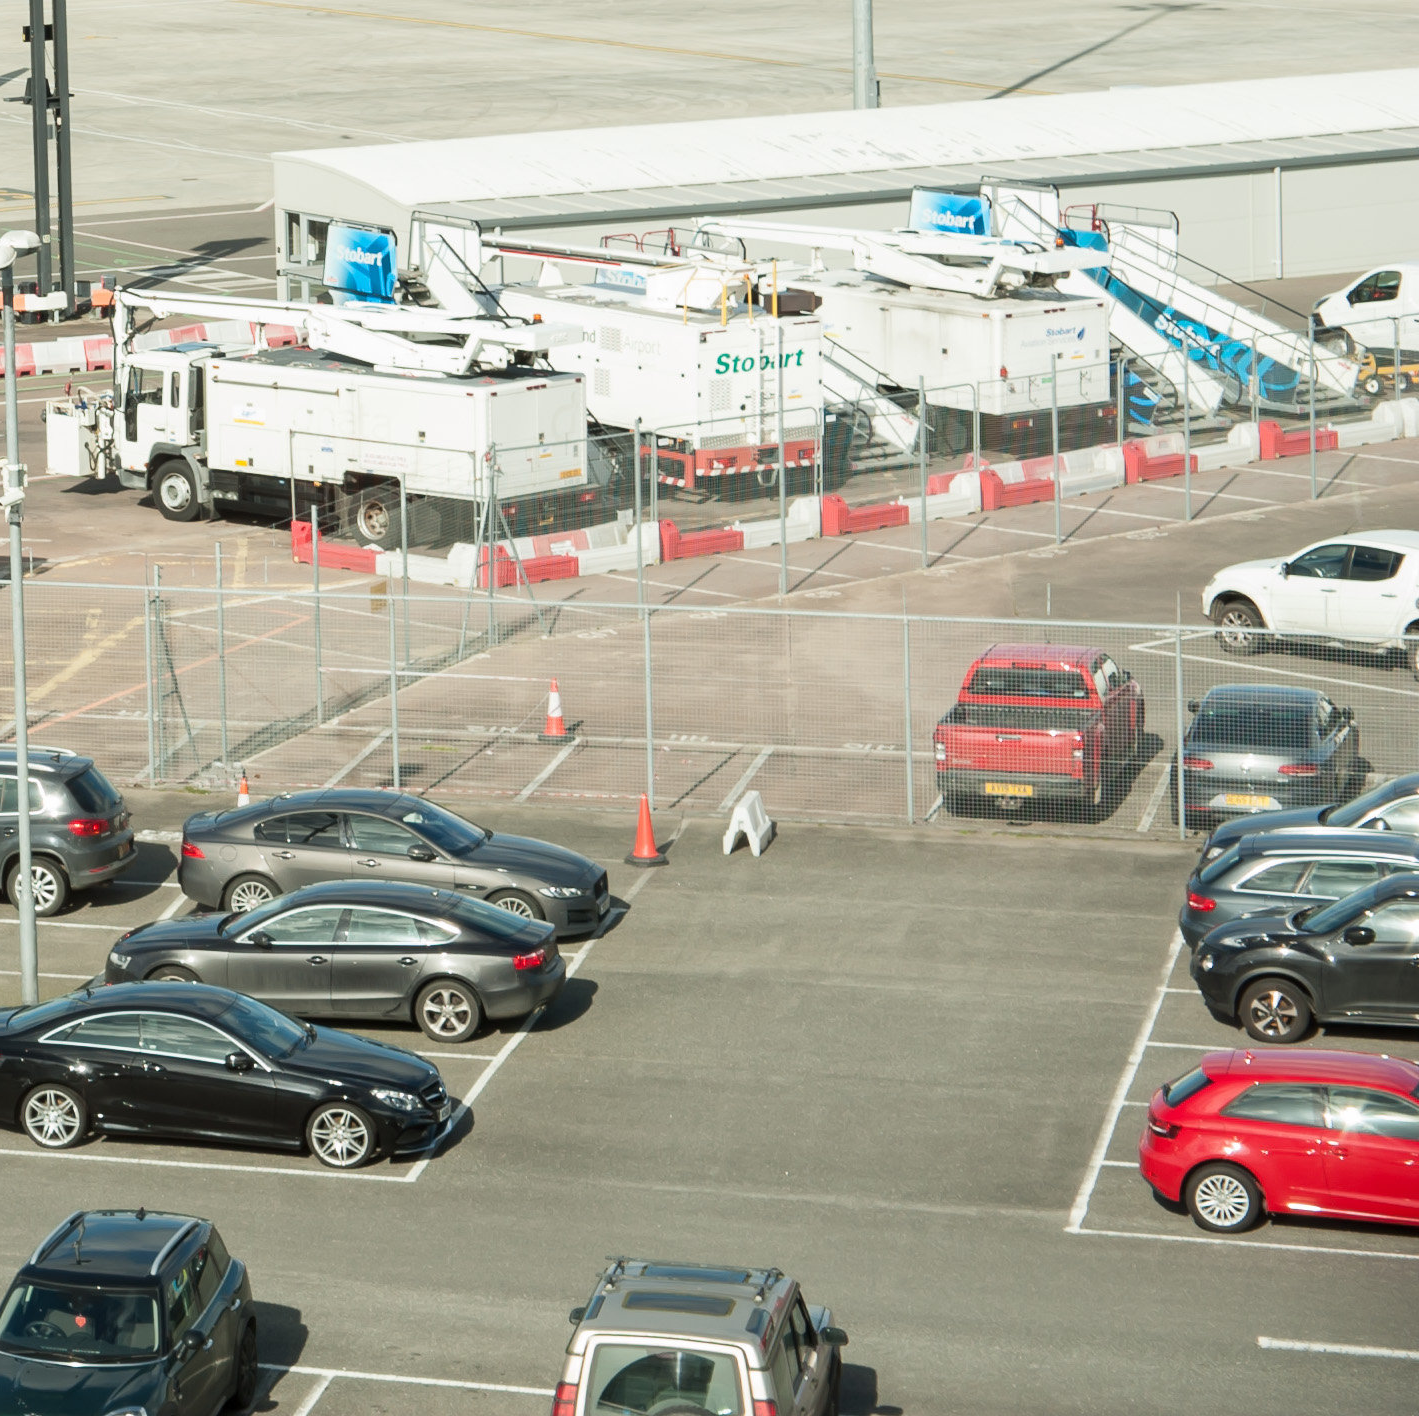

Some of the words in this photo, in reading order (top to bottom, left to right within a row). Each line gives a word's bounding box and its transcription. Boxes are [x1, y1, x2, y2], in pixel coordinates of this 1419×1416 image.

[922, 207, 976, 230] Stobart
[336, 244, 383, 267] Stobart
[715, 348, 805, 375] Stobart
